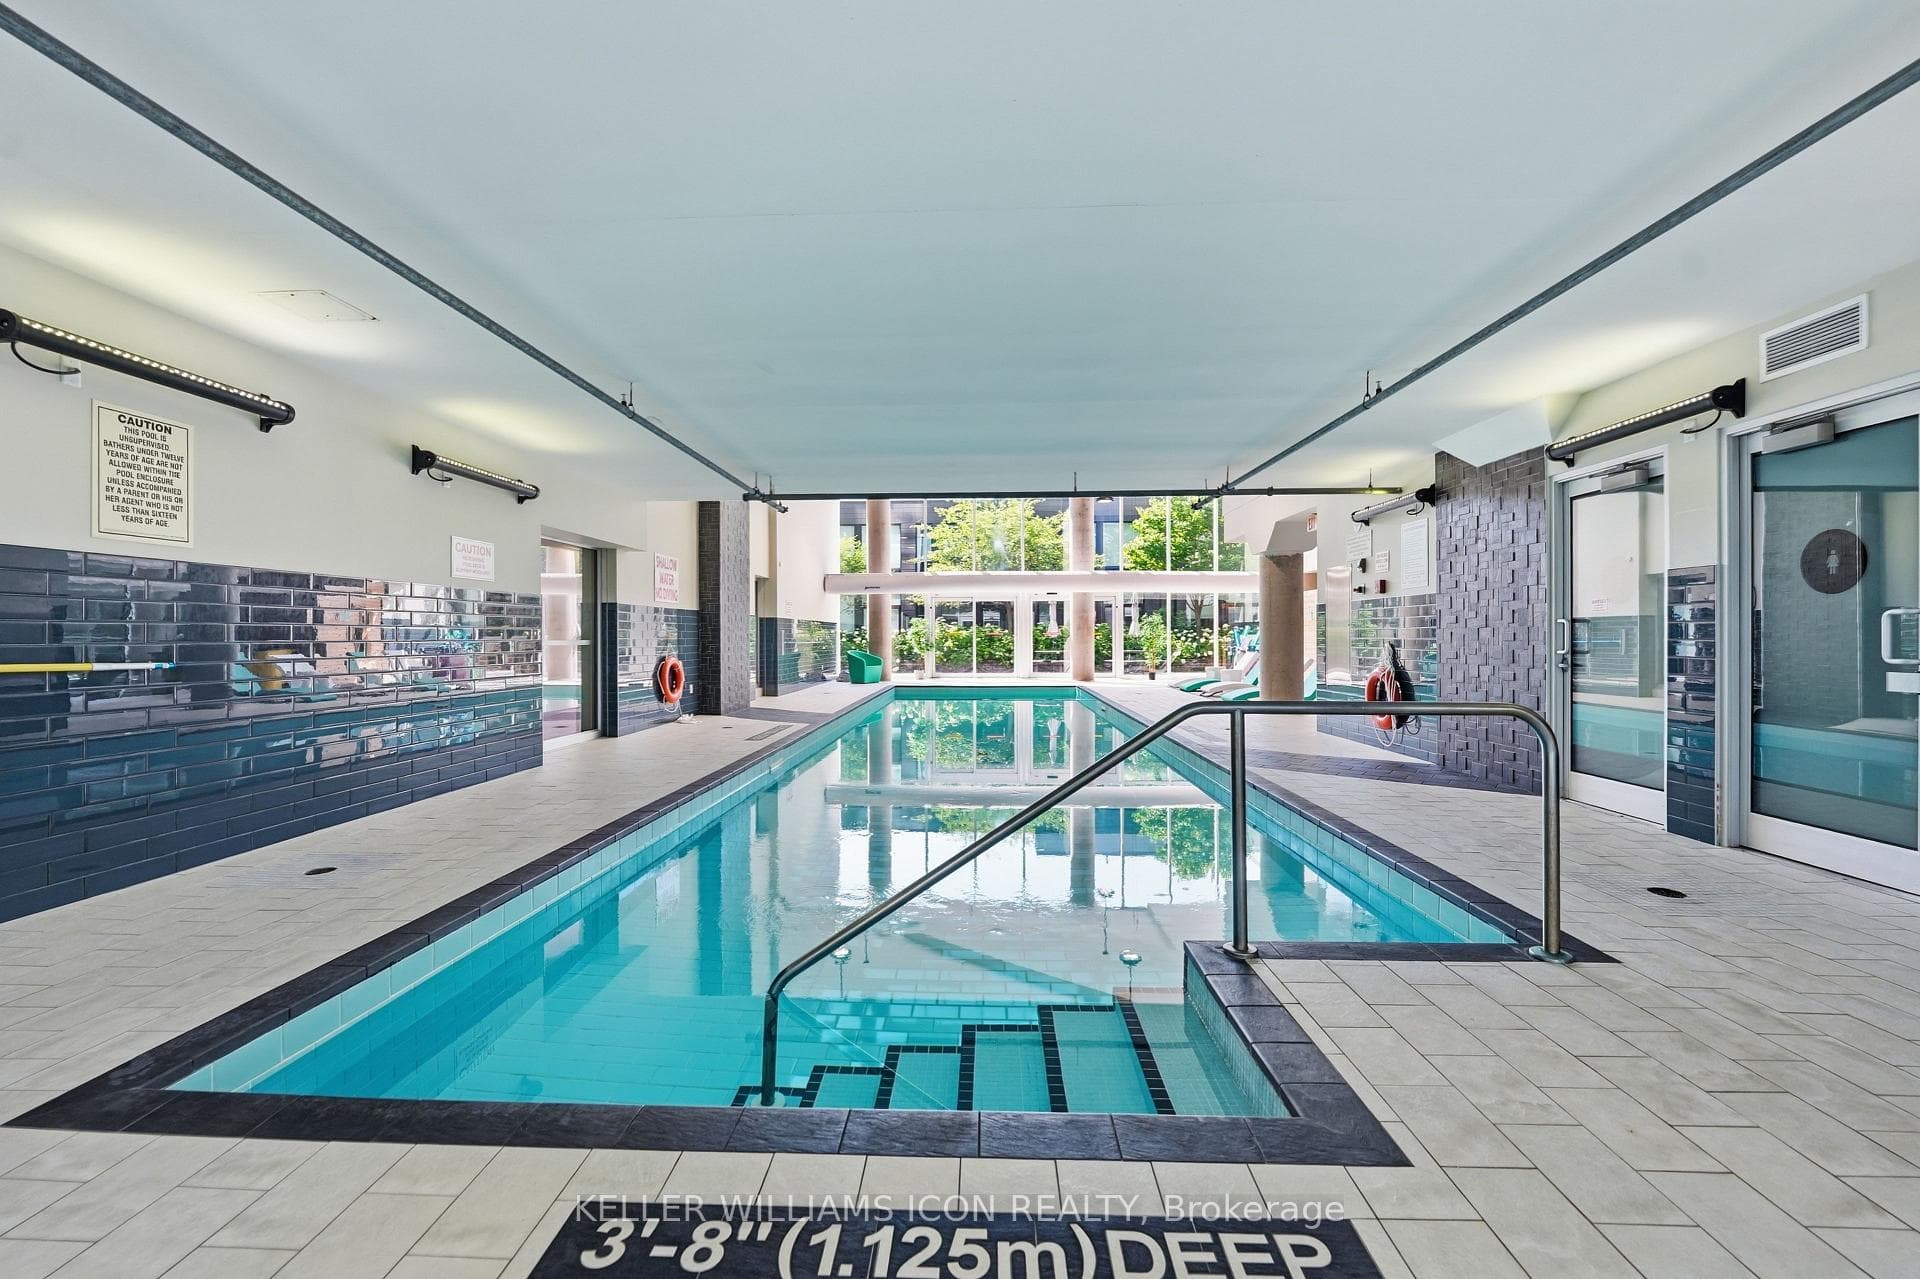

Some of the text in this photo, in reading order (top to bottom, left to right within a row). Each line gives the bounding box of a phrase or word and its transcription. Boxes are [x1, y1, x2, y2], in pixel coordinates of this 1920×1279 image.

[118, 414, 172, 434] CAUTION
[124, 426, 167, 442] THIS POOL IS
[103, 439, 185, 463] BATHERS UNDER TWELVE
[106, 449, 183, 471] YEARS OF AGE ARE NOT
[109, 458, 181, 478] ALLOWED WITHIN THE
[116, 469, 174, 486] POOL ENCLOSURE
[105, 485, 184, 505] BY A PARENT OR HIS OR
[107, 476, 182, 496] UNLESS ACCOMPANIED
[105, 494, 183, 513] HER AGENT WHO IS NOT
[112, 504, 178, 521] LESS THAN SIXTEEN
[121, 514, 144, 525] YEARS
[145, 517, 154, 526] OF
[455, 542, 492, 558] CAUTION
[1104, 1229, 1333, 1279] DEEP
